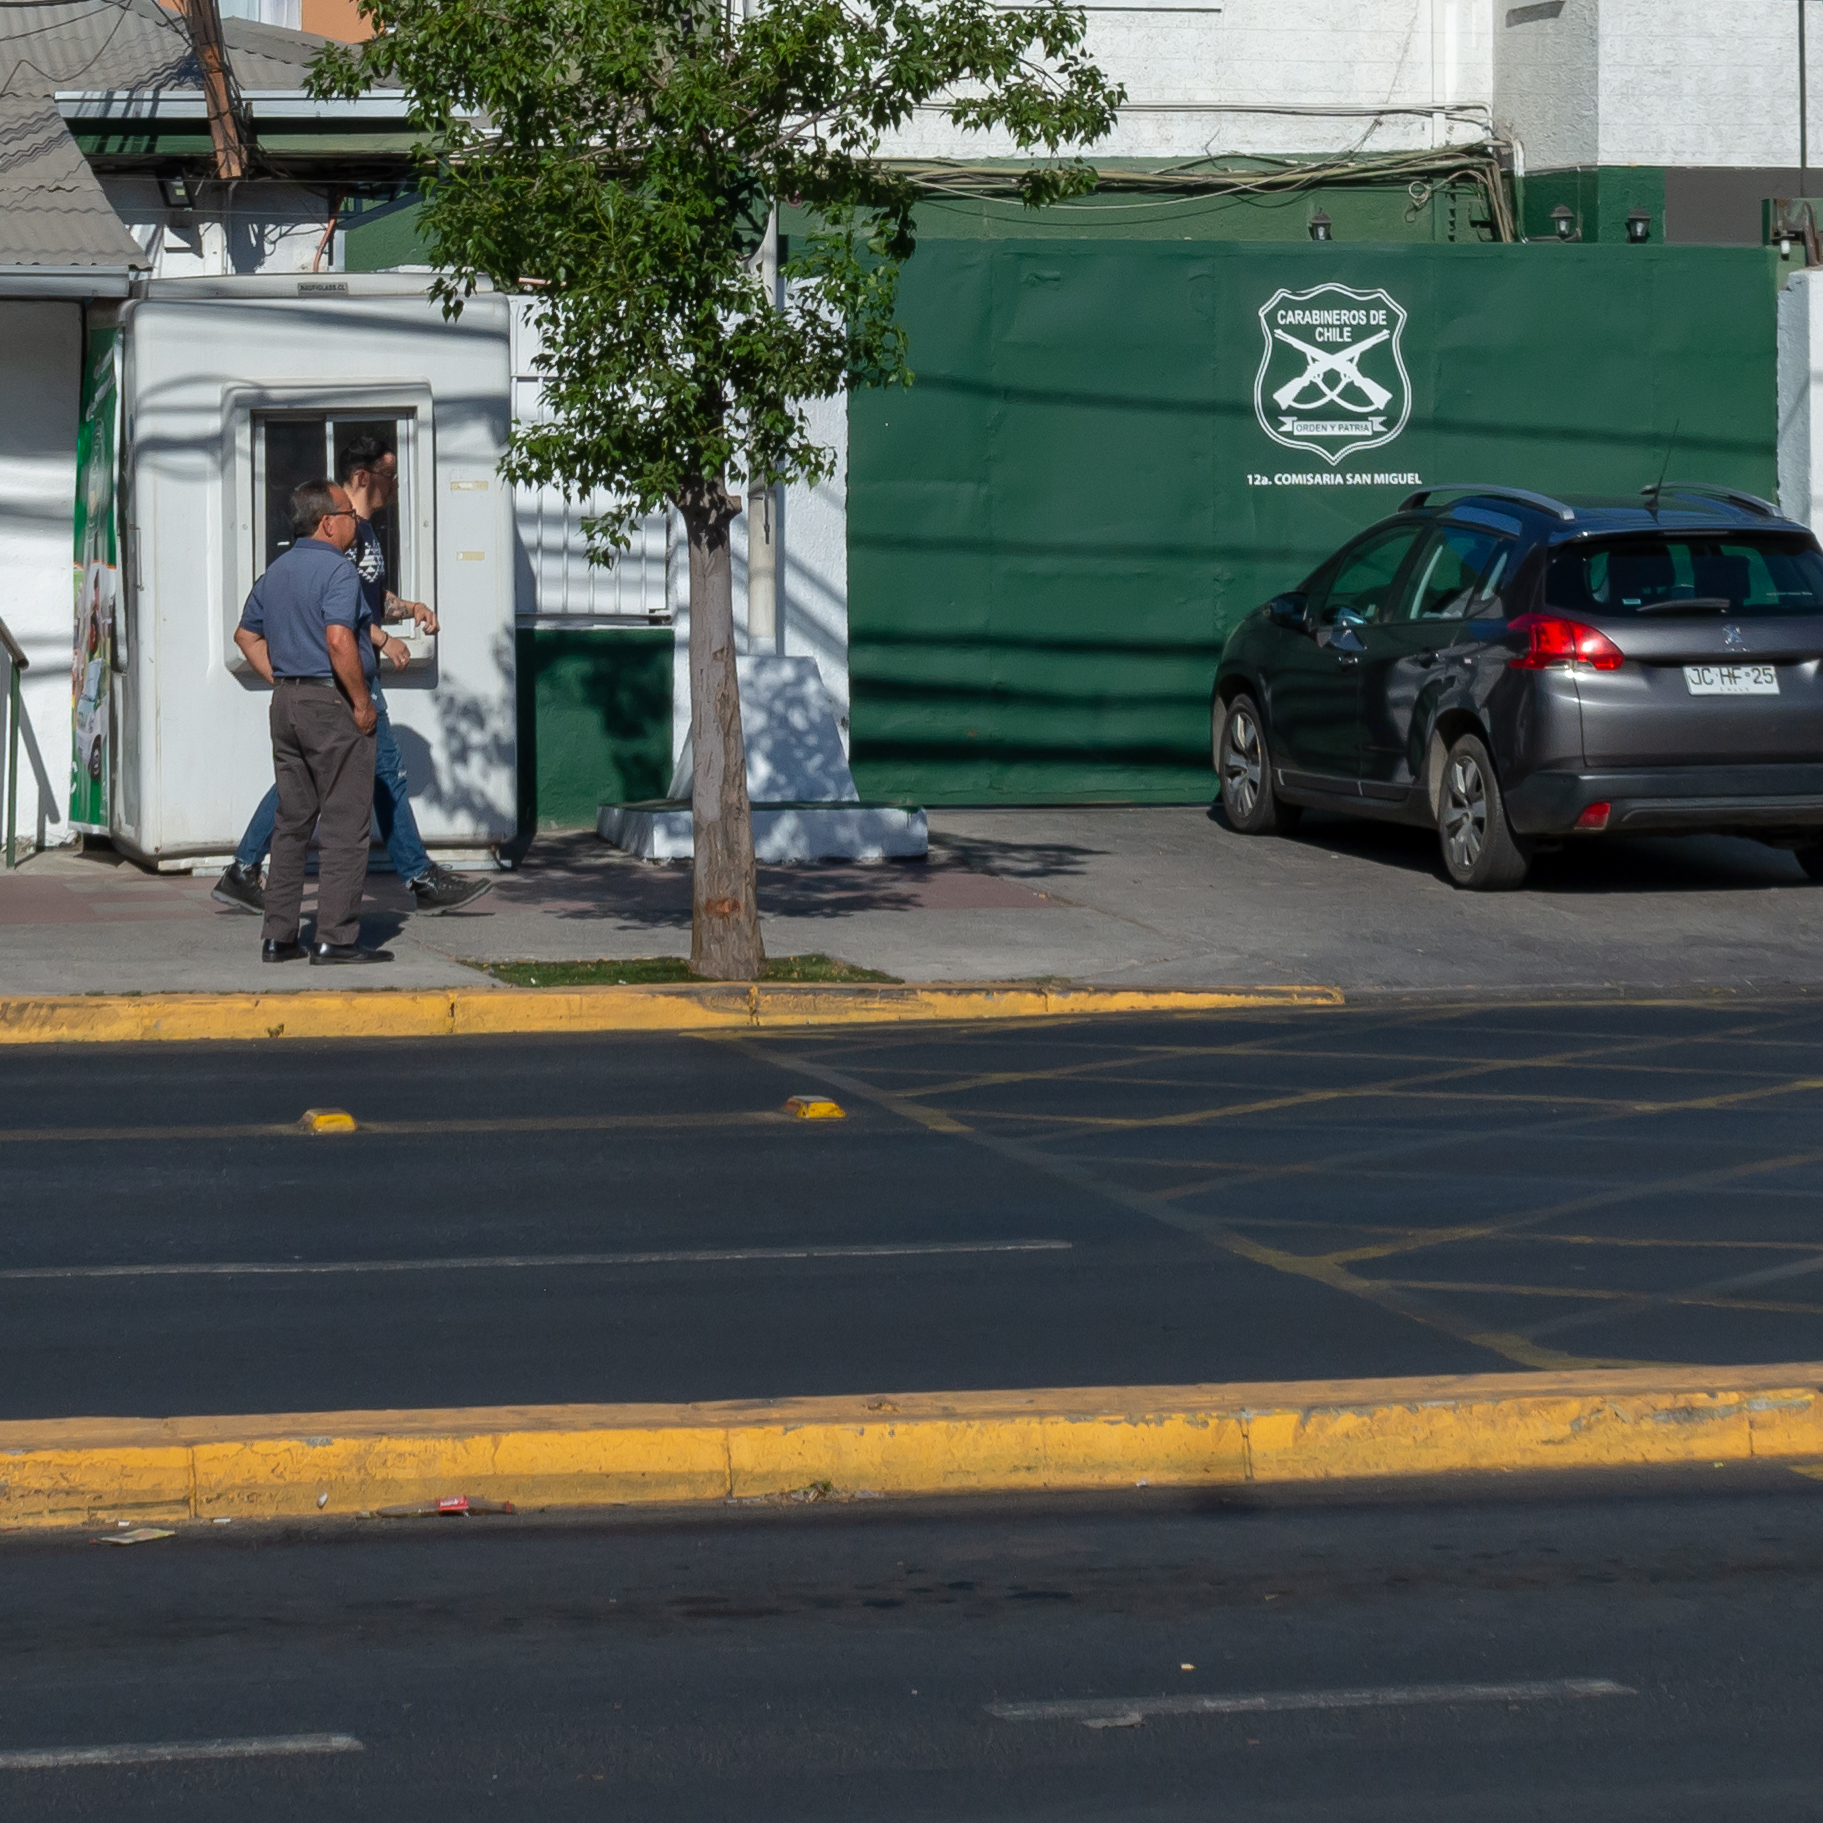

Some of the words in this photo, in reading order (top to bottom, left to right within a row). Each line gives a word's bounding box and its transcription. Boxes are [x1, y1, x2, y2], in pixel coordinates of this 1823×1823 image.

[1277, 310, 1367, 325] CARABINEROS
[1370, 310, 1387, 325] DE
[1315, 327, 1352, 342] CHILE
[1296, 423, 1327, 433] ORDEN
[1329, 423, 1336, 432] Y
[1337, 423, 1370, 432] PATRIA
[1274, 473, 1344, 485] COMISARIA
[1345, 473, 1372, 485] SAN
[1373, 473, 1423, 485] MIGUEL
